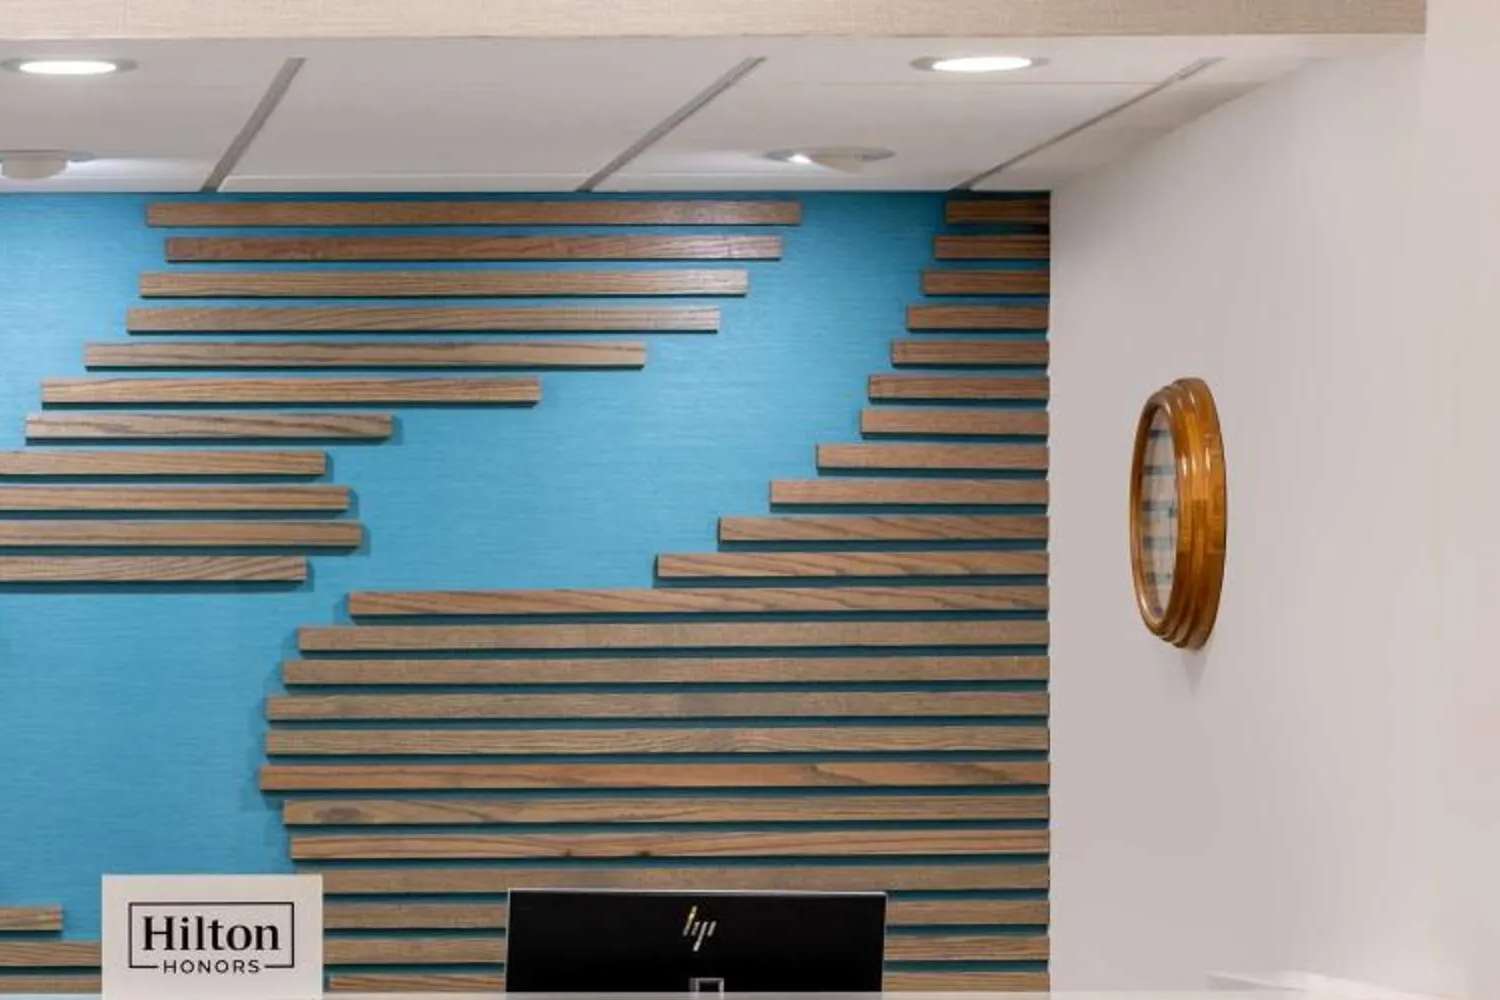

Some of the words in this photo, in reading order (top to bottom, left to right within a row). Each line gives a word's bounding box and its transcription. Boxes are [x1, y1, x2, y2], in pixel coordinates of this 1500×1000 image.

[142, 915, 281, 951] Hilton
[682, 905, 717, 952] hp
[163, 959, 261, 974] HONORS
